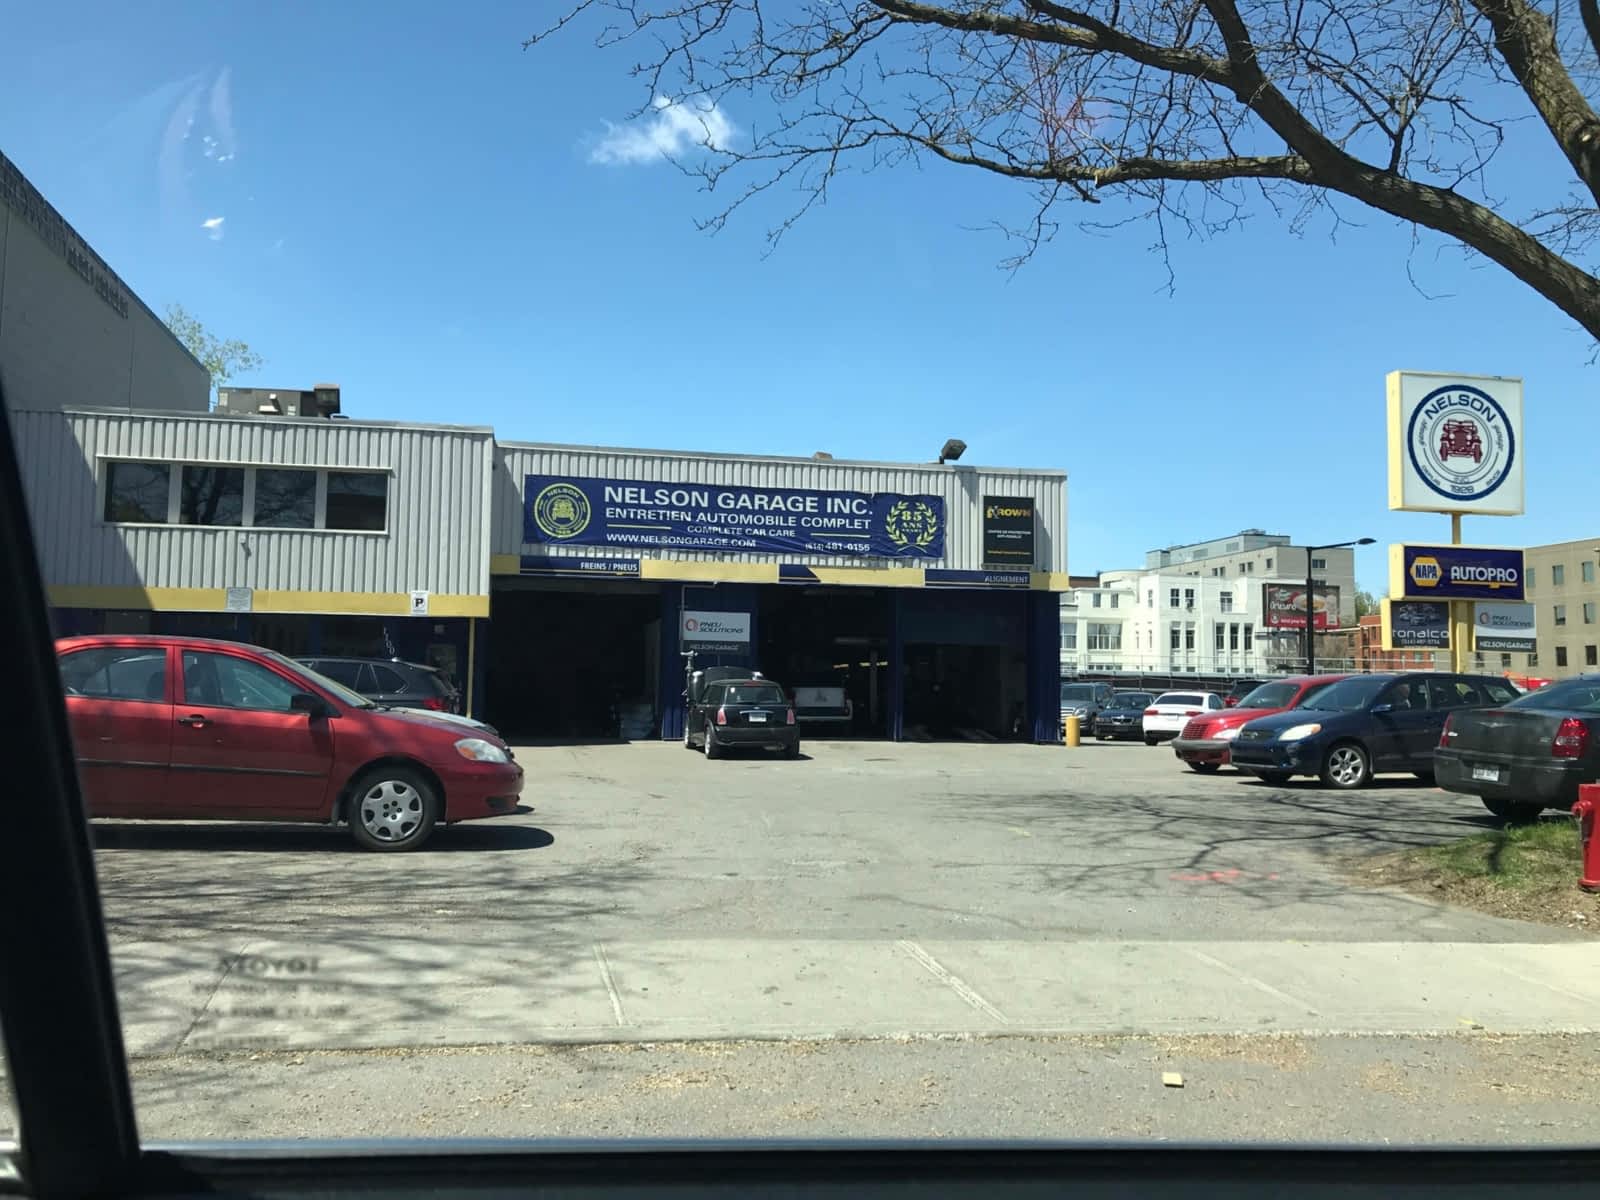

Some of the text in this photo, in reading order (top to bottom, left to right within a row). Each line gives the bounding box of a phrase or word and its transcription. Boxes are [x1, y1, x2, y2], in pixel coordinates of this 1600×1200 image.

[1424, 394, 1496, 423] NELSON
[546, 488, 581, 499] NELSON
[604, 486, 709, 508] NELSON
[717, 492, 818, 513] GARAGE
[826, 498, 873, 515] INC.
[605, 507, 872, 530] ENTRETIEN AUTOMOBILE COMPLET
[902, 511, 922, 521] 85
[687, 525, 796, 538] COMPLETE CAR CARE
[606, 533, 756, 548] WWW.NELSONGARAGE.COM
[580, 562, 607, 570] FREINS
[613, 563, 638, 572] PNEUS
[1415, 565, 1438, 579] NAPA
[984, 575, 1029, 584] ALIGNEMENT
[1451, 566, 1518, 582] AUTOPRO
[415, 598, 424, 607] P
